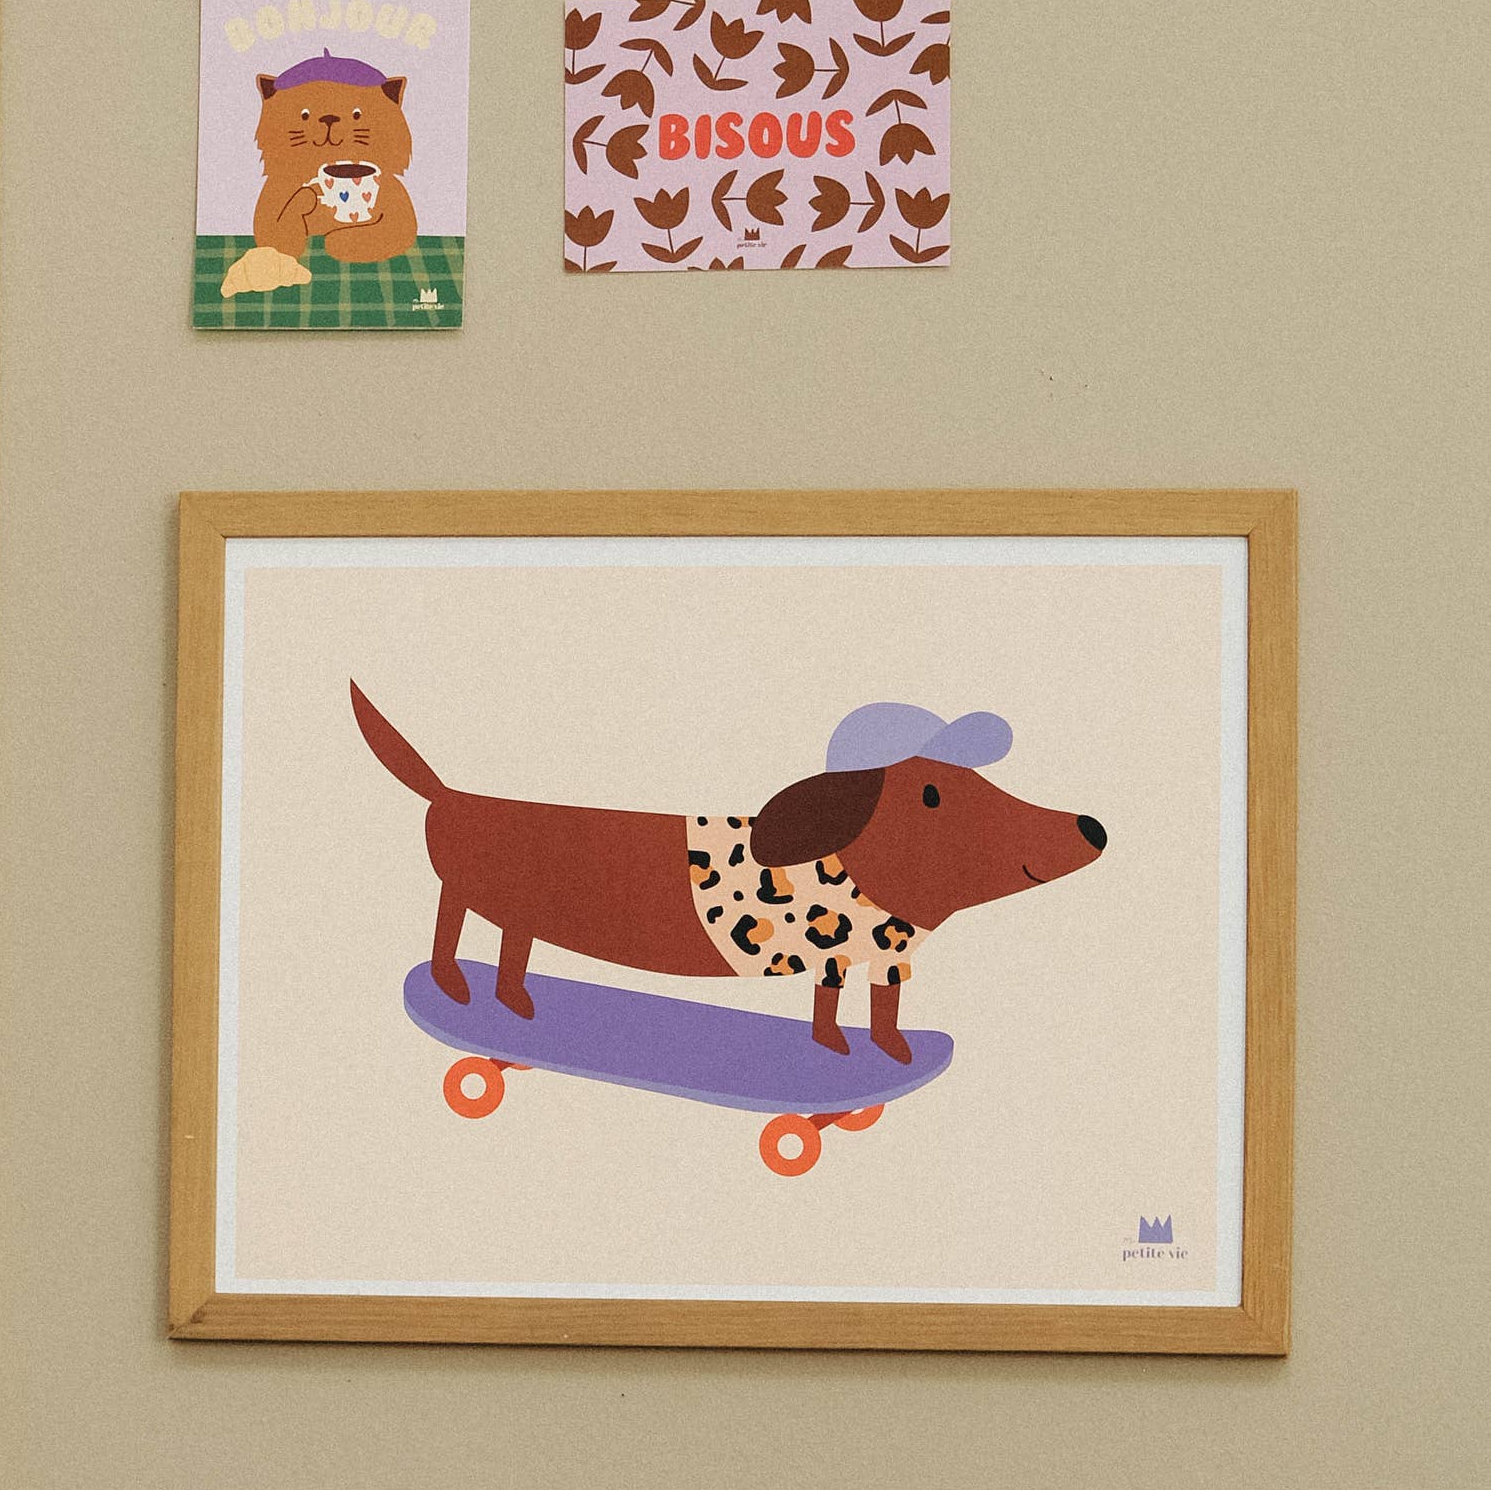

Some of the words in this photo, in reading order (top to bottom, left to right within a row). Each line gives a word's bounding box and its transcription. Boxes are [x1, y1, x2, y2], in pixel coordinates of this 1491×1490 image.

[658, 109, 857, 161] BISOUS
[1122, 1247, 1165, 1262] petite
[1168, 1246, 1189, 1260] vie
